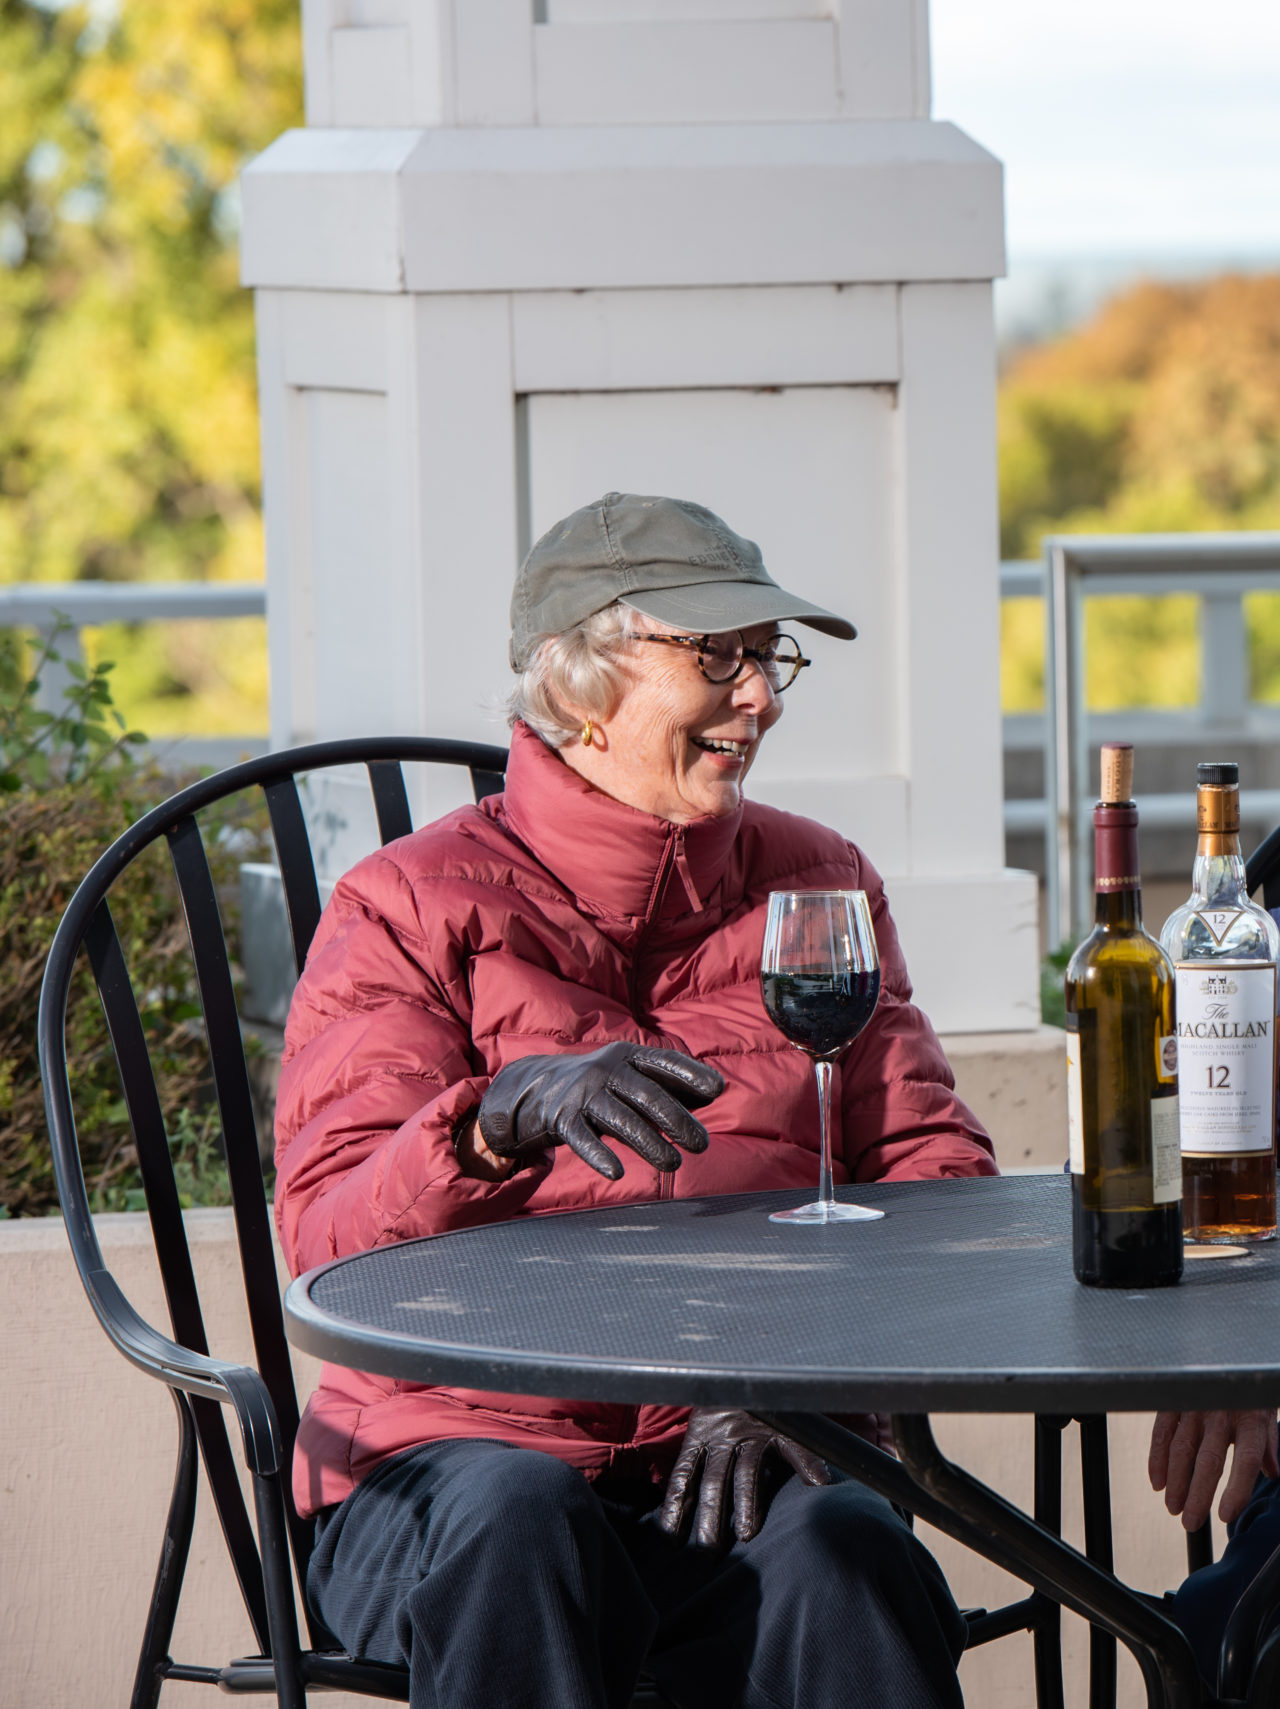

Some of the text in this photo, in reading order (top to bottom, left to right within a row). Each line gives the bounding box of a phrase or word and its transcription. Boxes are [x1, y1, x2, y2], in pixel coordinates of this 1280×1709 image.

[1213, 913, 1227, 924] 12
[1203, 1003, 1230, 1020] The
[1178, 1021, 1268, 1038] ACALLAN
[1206, 1065, 1231, 1089] 12
